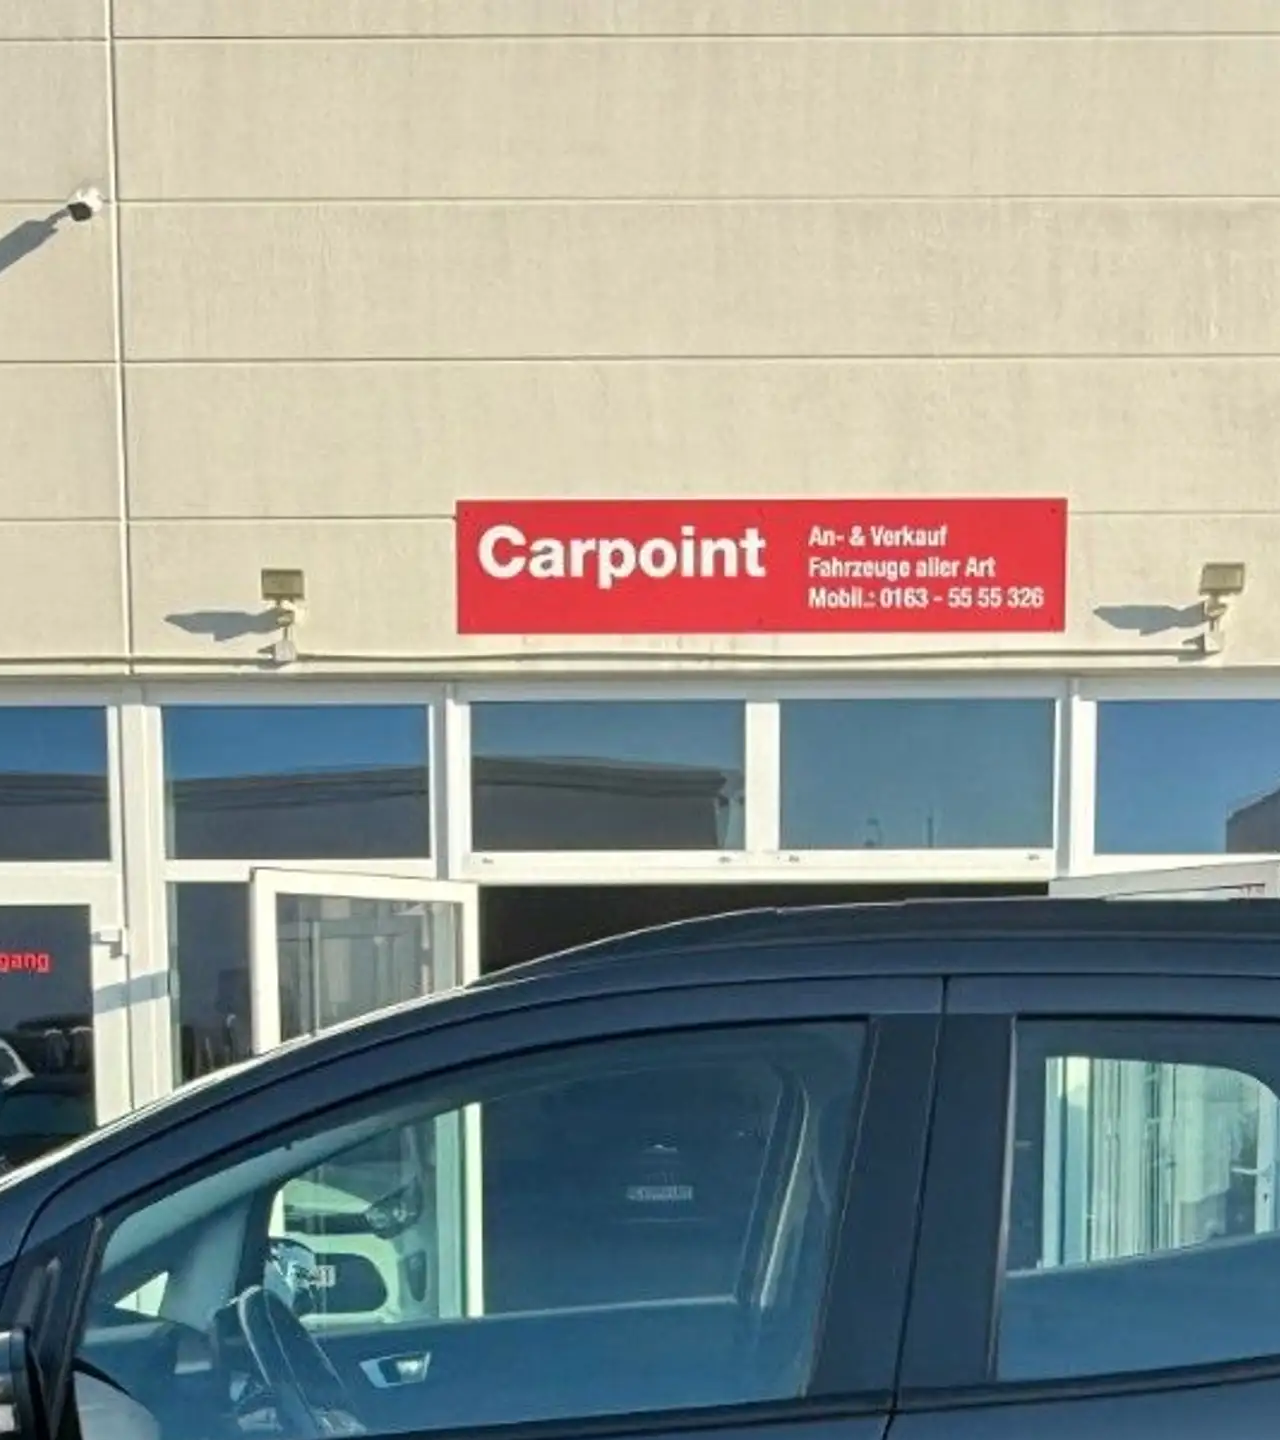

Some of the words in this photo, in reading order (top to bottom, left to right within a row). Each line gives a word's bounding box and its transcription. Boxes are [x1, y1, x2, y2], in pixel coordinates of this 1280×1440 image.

[808, 525, 845, 547] An-
[849, 525, 866, 547] &
[871, 525, 948, 547] Verkauf
[478, 524, 767, 589] Carpoint
[808, 557, 911, 581] Fahrzeuge
[915, 557, 960, 578] aller
[965, 557, 996, 578] Art
[880, 586, 929, 608] 0163
[948, 586, 973, 608] 55
[977, 586, 1003, 608] 55
[1007, 586, 1044, 608] 326
